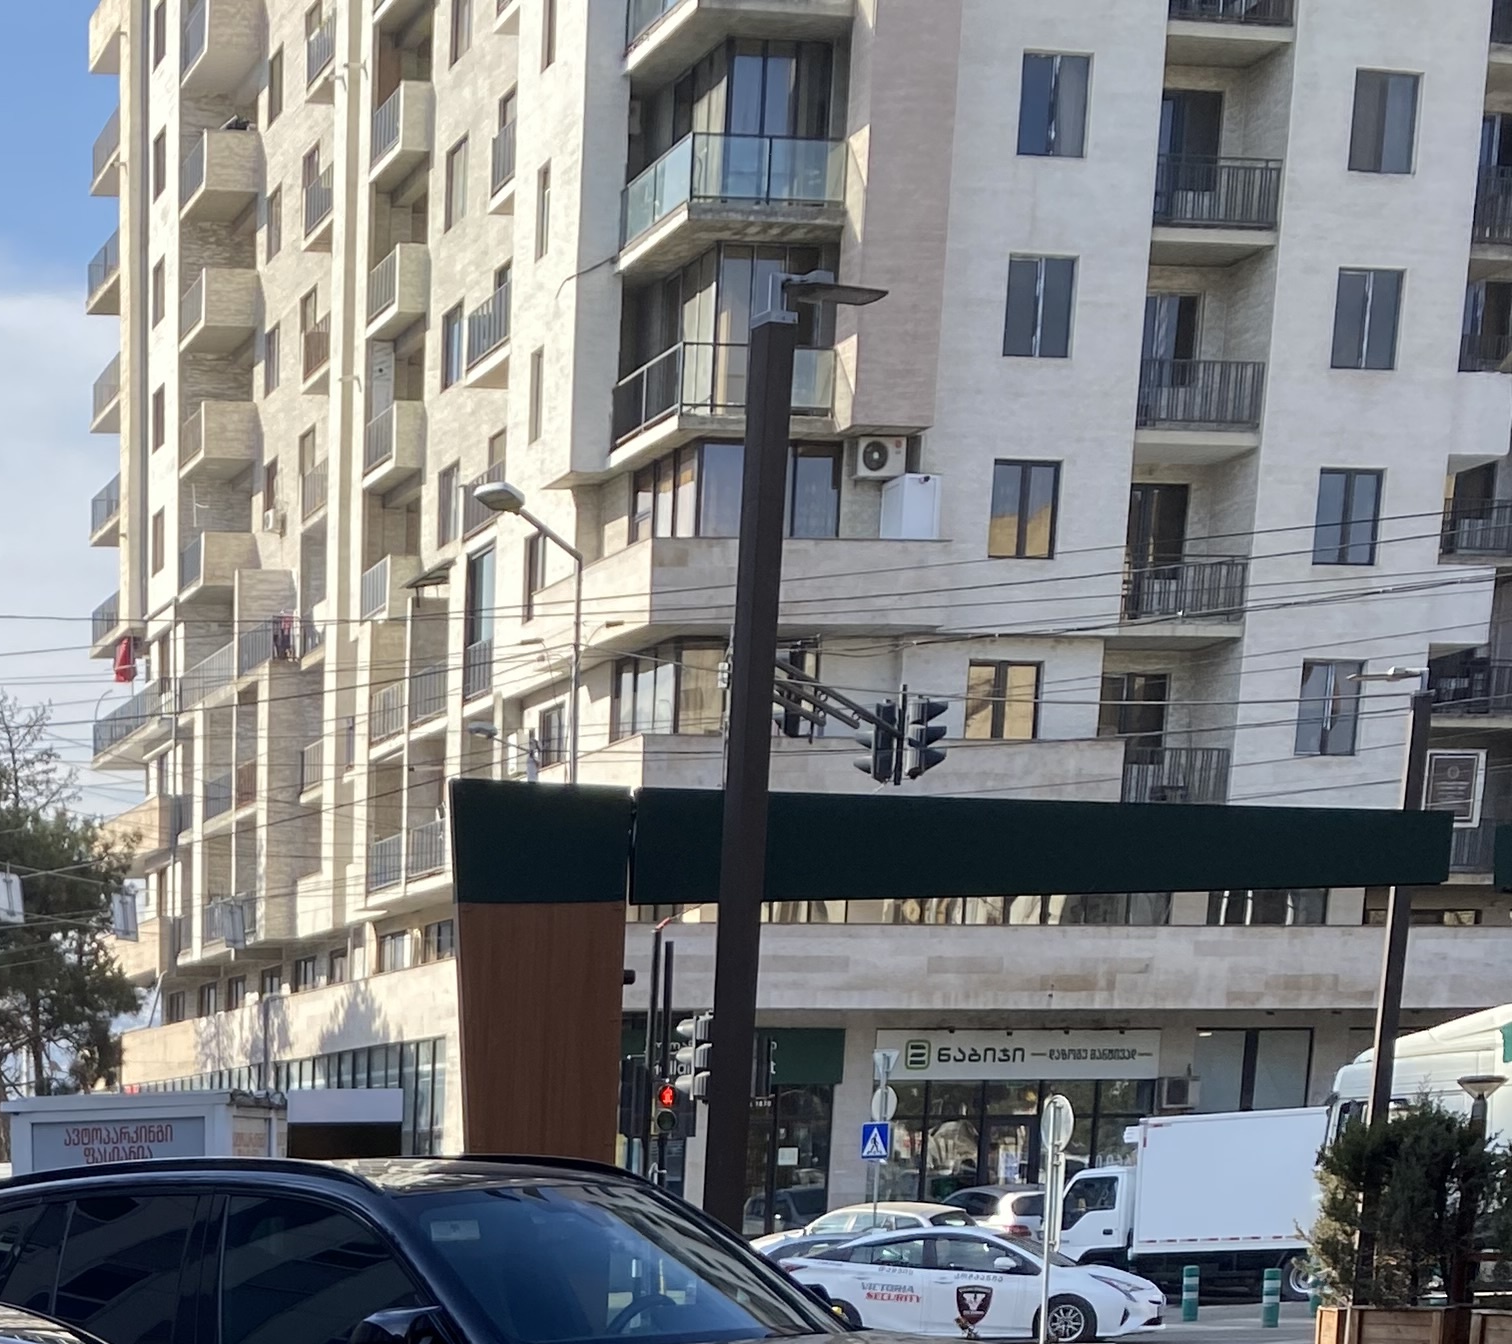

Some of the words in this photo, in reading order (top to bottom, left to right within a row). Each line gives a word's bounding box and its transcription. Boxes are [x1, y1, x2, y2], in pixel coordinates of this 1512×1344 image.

[937, 1047, 1025, 1063] ნაბიჯი
[64, 1124, 173, 1147] ავტოპარკინგი
[861, 1282, 915, 1293] VICTORIA
[865, 1292, 922, 1303] SECURITY
